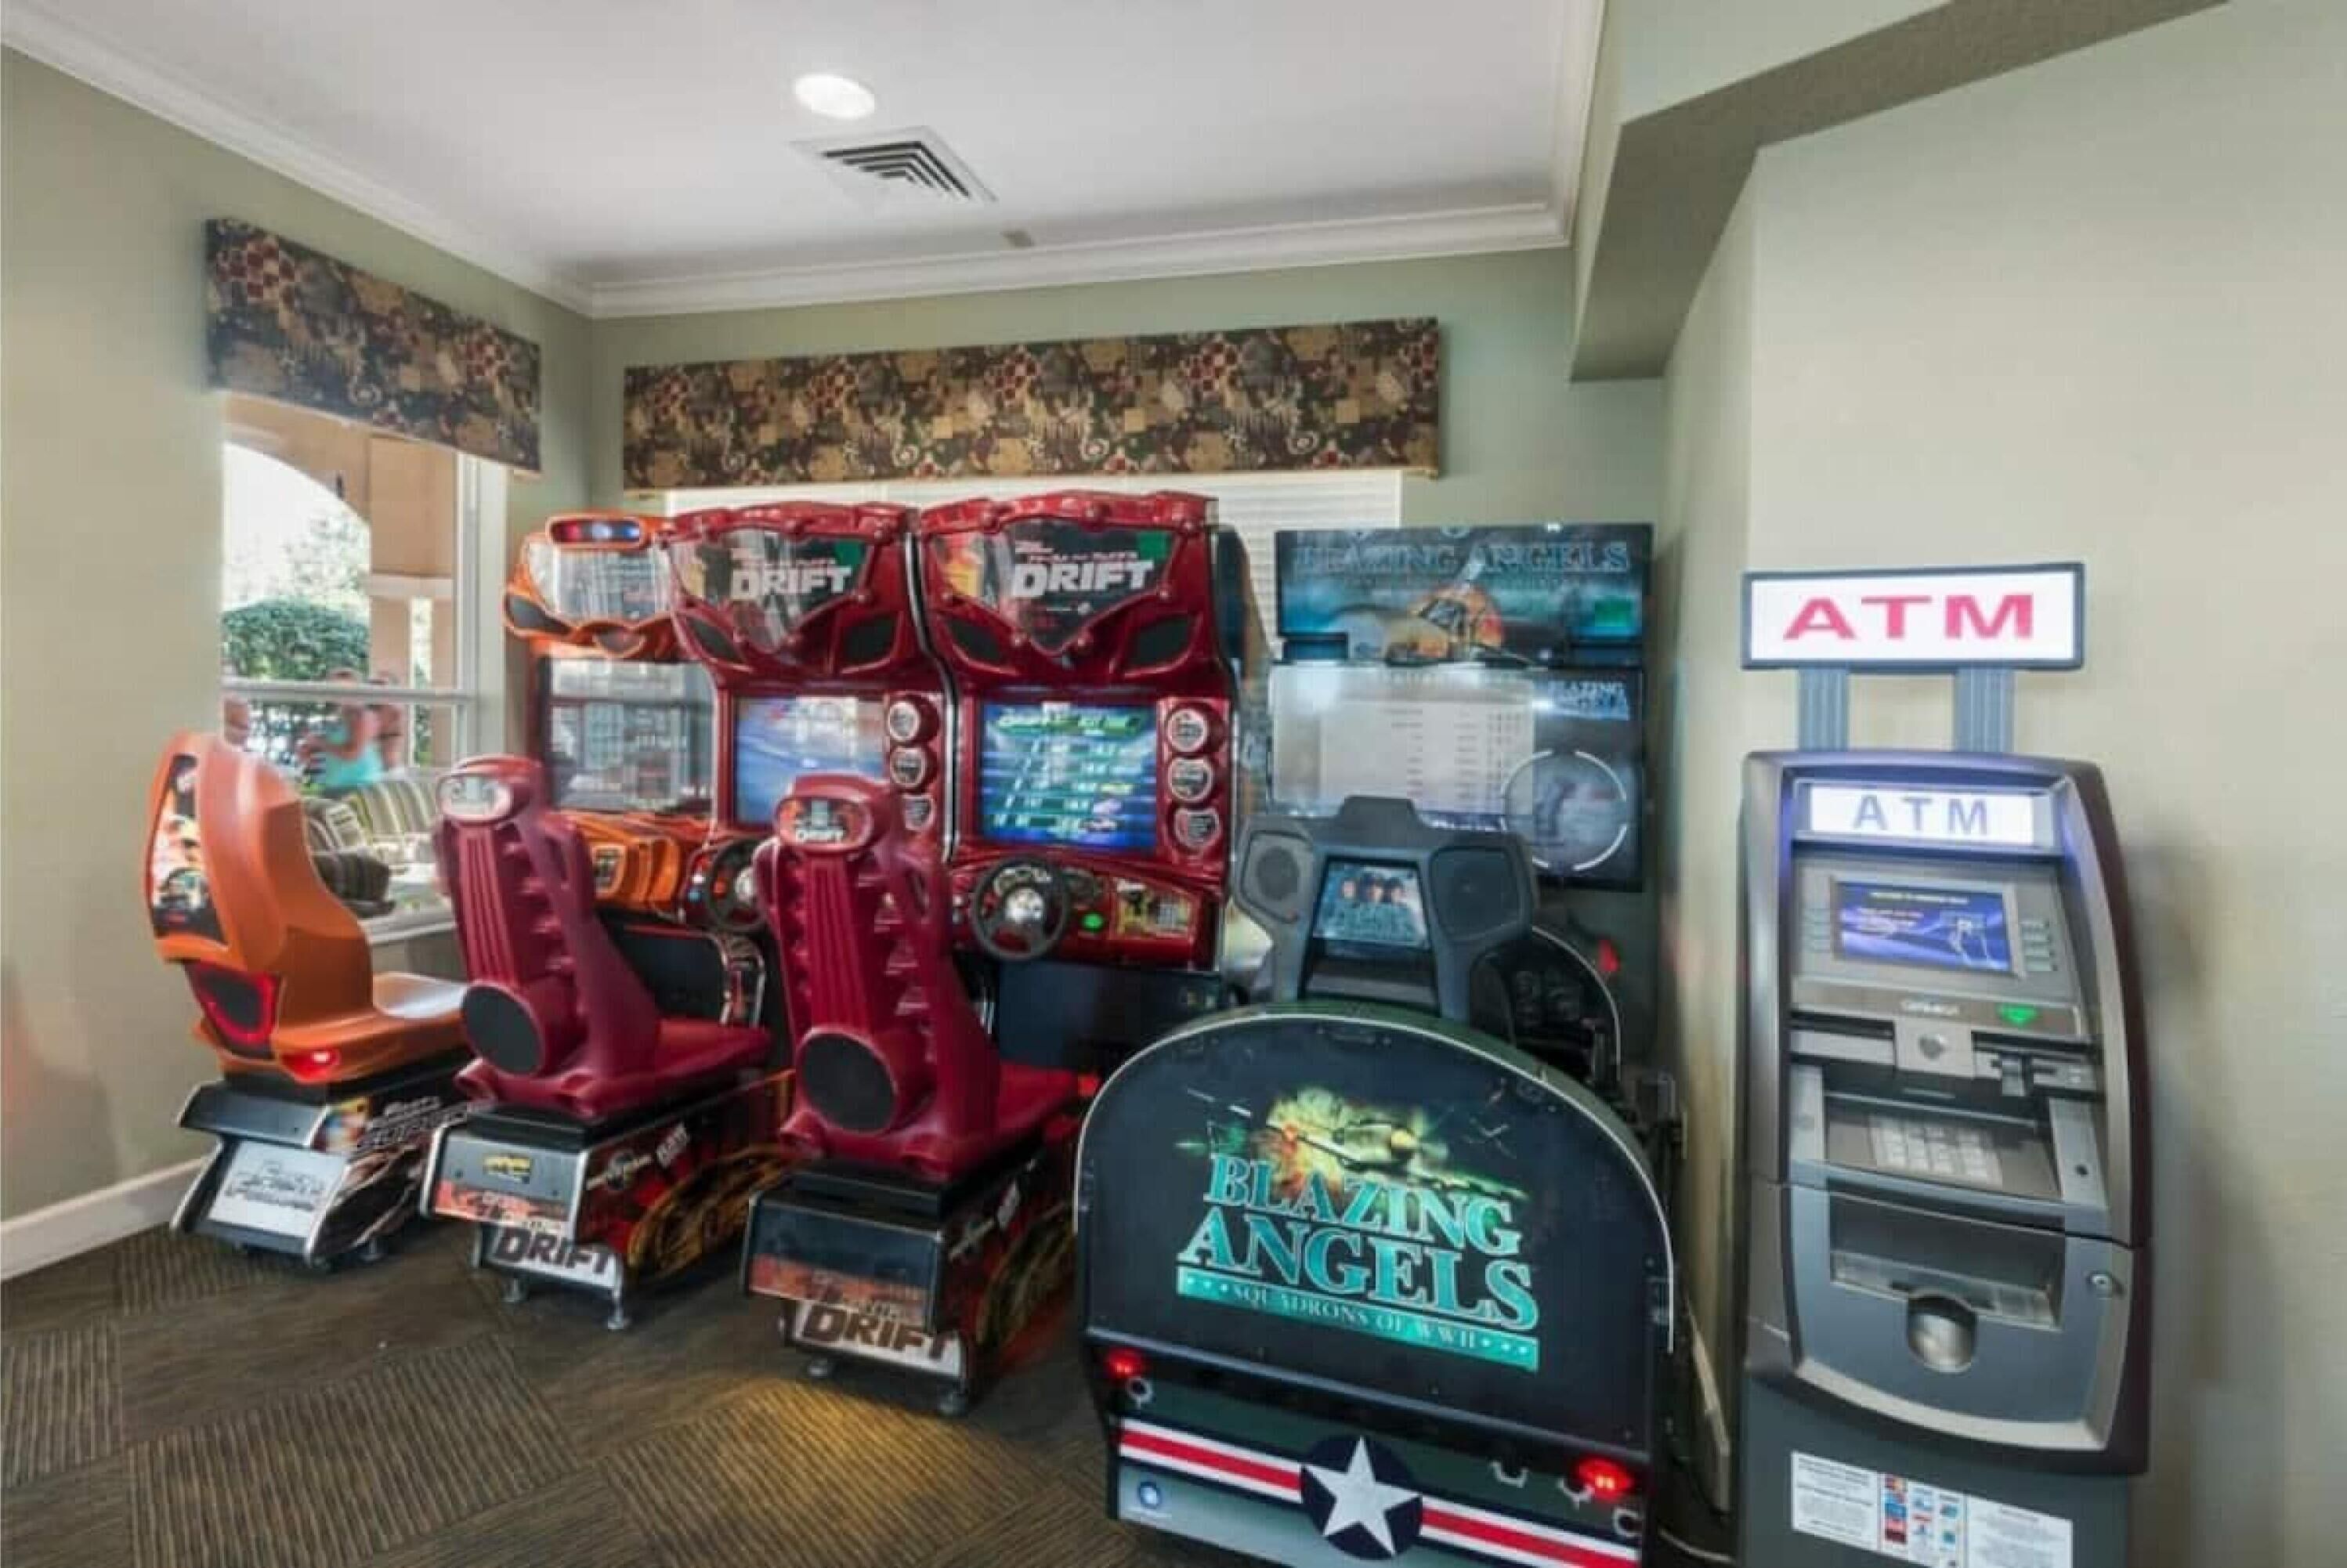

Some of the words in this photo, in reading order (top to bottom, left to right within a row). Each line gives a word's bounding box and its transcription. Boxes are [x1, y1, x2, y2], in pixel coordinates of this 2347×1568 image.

[729, 565, 852, 602] DRIFT
[1011, 559, 1155, 598] DRIFT
[1783, 593, 2034, 640] ATM
[1852, 794, 1988, 836] ATM
[1202, 1153, 1521, 1254] BLAZING
[494, 1227, 615, 1275] DRIFT
[1177, 1205, 1539, 1330] ANGELS
[802, 1304, 956, 1360] DRIFT
[1375, 1313, 1404, 1332] OF
